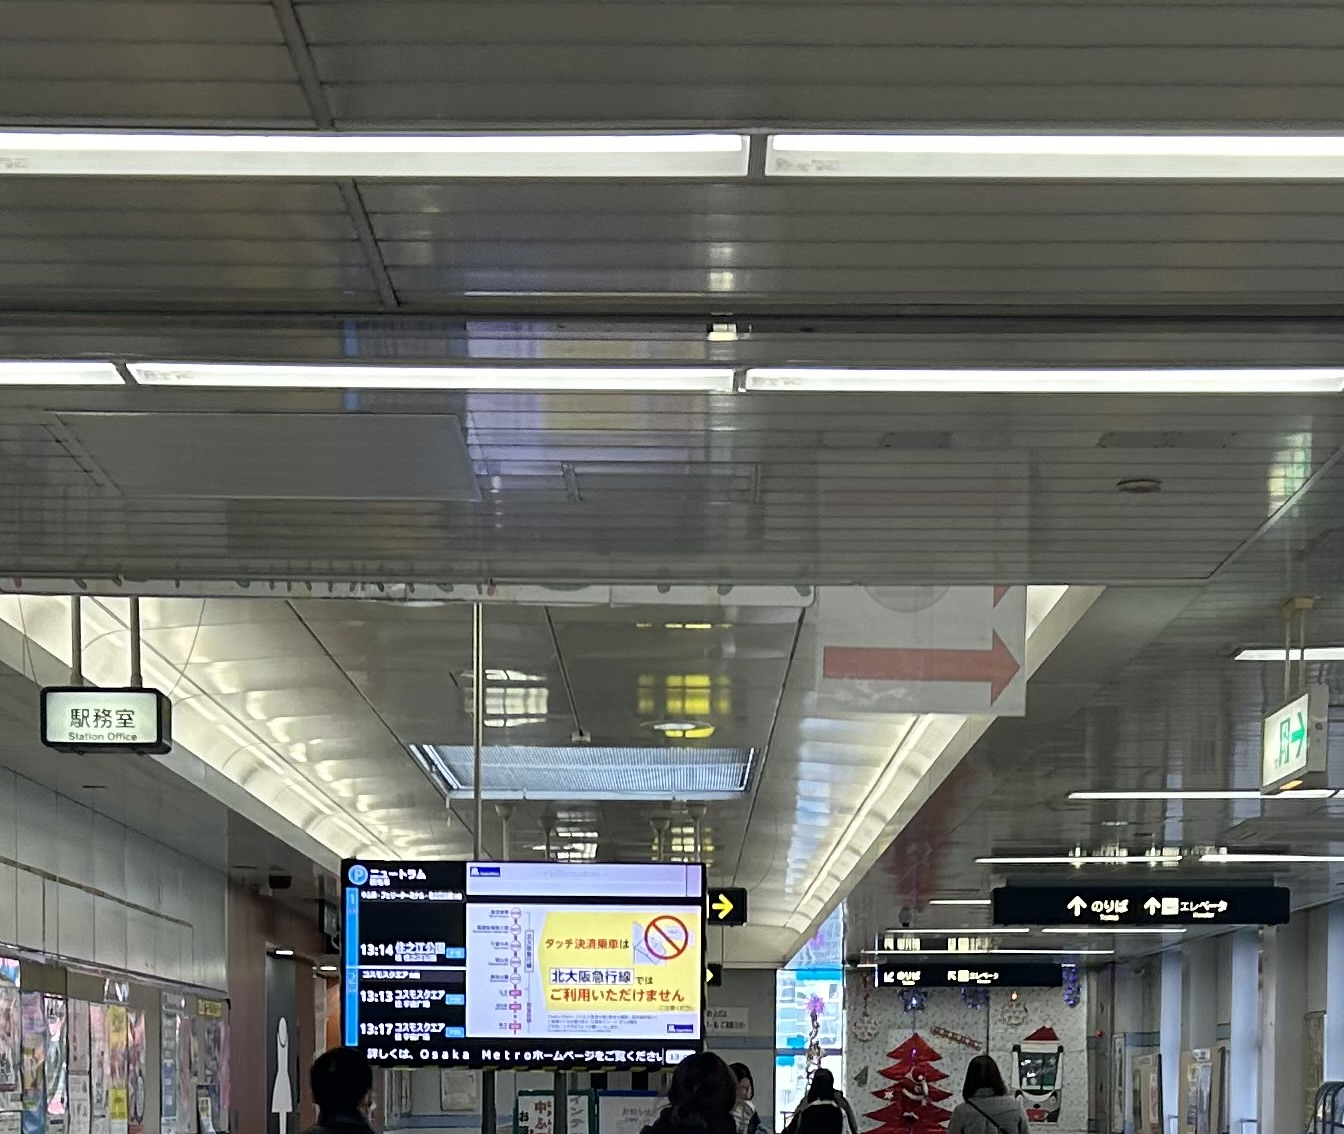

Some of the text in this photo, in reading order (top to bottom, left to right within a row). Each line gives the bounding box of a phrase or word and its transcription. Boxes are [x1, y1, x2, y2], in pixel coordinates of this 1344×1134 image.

[70, 708, 136, 729] 駅務室
[68, 732, 138, 741] Station Office
[369, 868, 427, 880] ニュートラム
[1091, 899, 1129, 913] のりば
[544, 938, 630, 949] タッチ決済乗車は
[360, 944, 394, 956] 13:14
[551, 969, 632, 983] 北大阪急行線
[635, 975, 653, 985] では
[360, 990, 393, 1002] 13:13
[394, 990, 445, 1000] コスモスクエア
[549, 988, 684, 1002] ご利用いただけません
[360, 1023, 393, 1035] 13:17
[394, 1023, 445, 1033] コスモスクエア
[419, 1049, 470, 1060] Osaka
